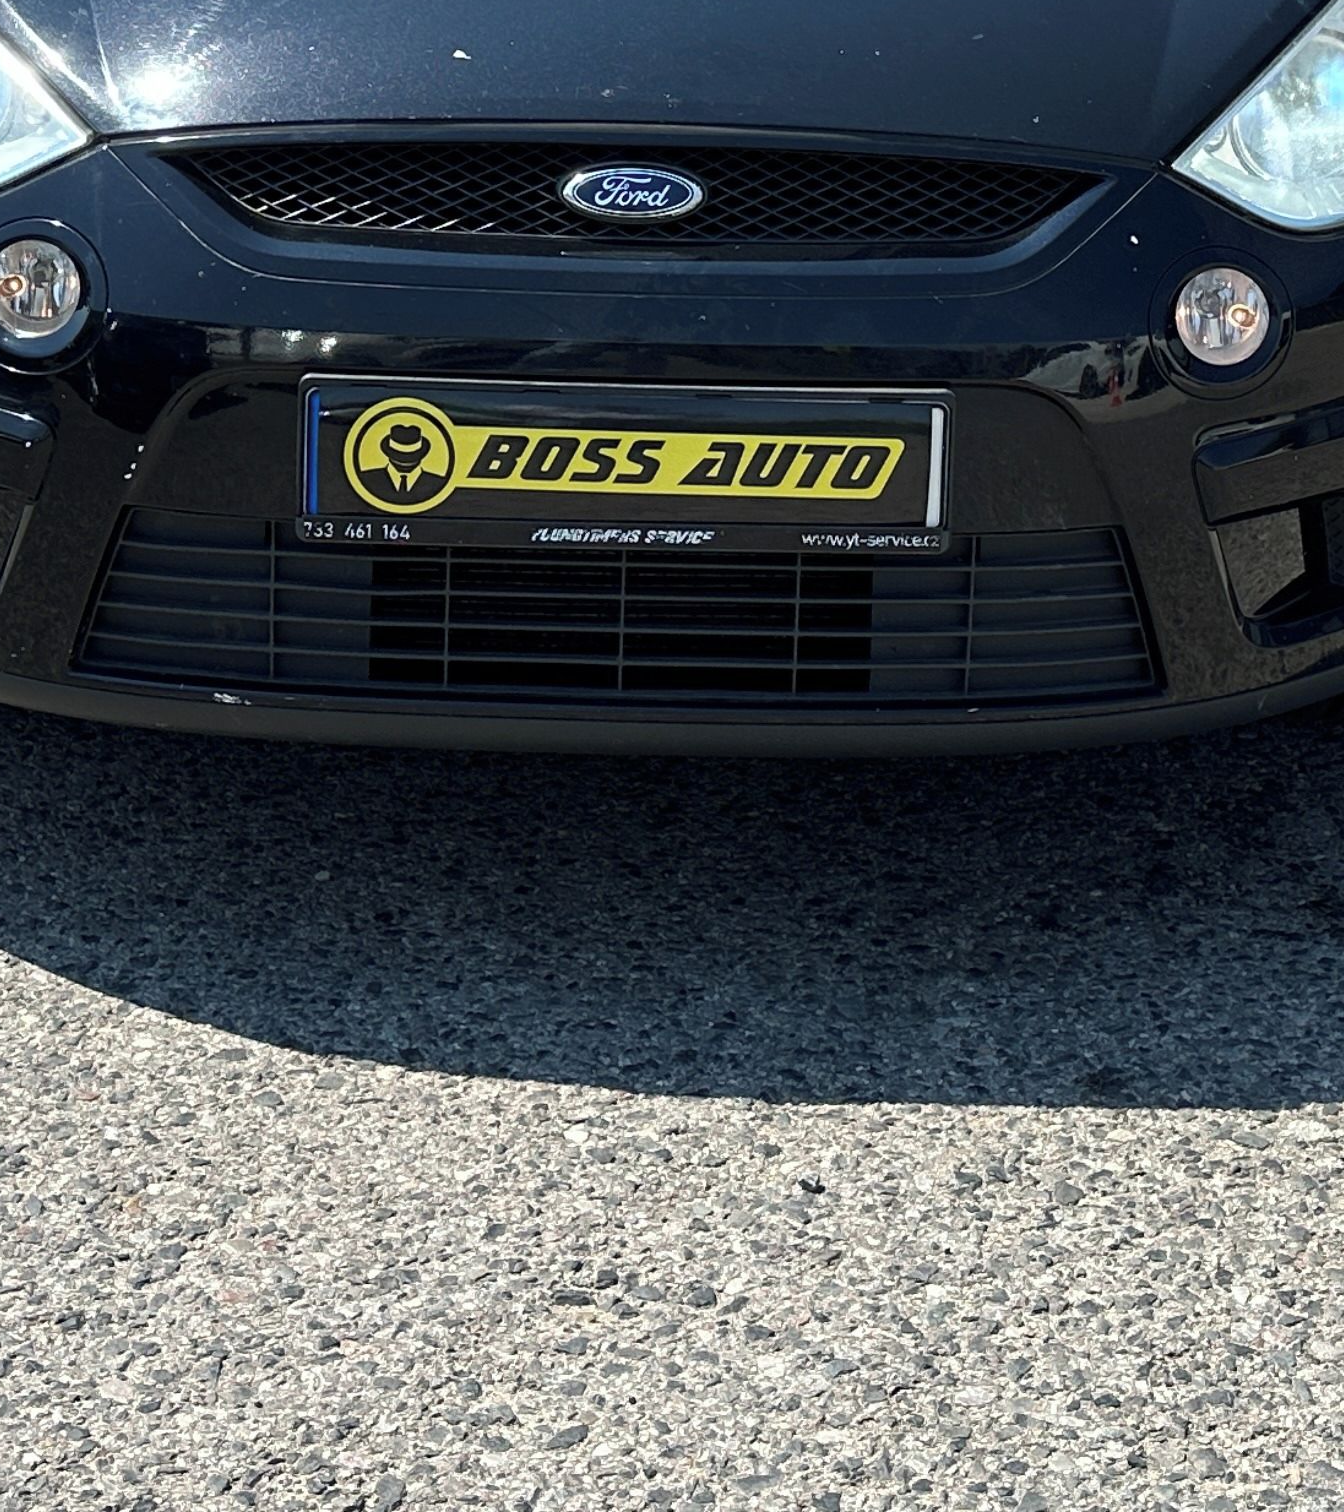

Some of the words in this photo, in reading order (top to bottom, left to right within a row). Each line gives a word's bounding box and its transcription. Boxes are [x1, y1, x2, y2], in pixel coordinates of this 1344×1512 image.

[594, 176, 671, 207] Ford
[467, 434, 666, 484] BOSS
[677, 442, 891, 489] AUTO
[382, 524, 411, 540] 164
